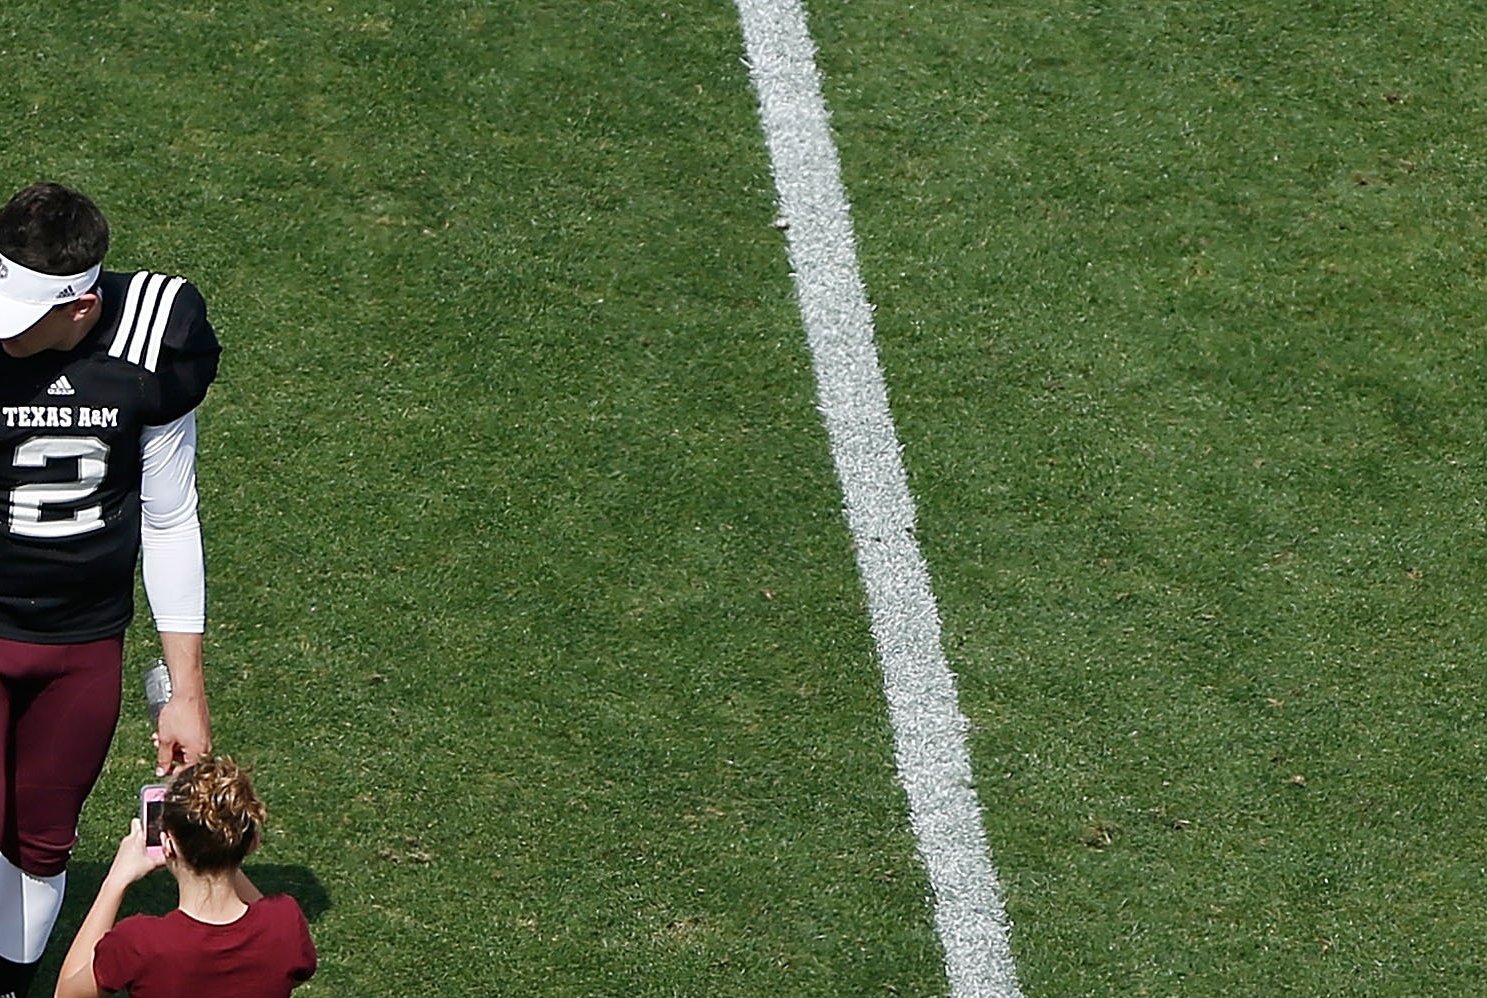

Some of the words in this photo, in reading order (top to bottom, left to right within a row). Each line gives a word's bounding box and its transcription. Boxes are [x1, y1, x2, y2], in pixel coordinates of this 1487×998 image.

[2, 406, 72, 427] TEXAS
[78, 407, 119, 427] A&M
[9, 435, 110, 538] 2
